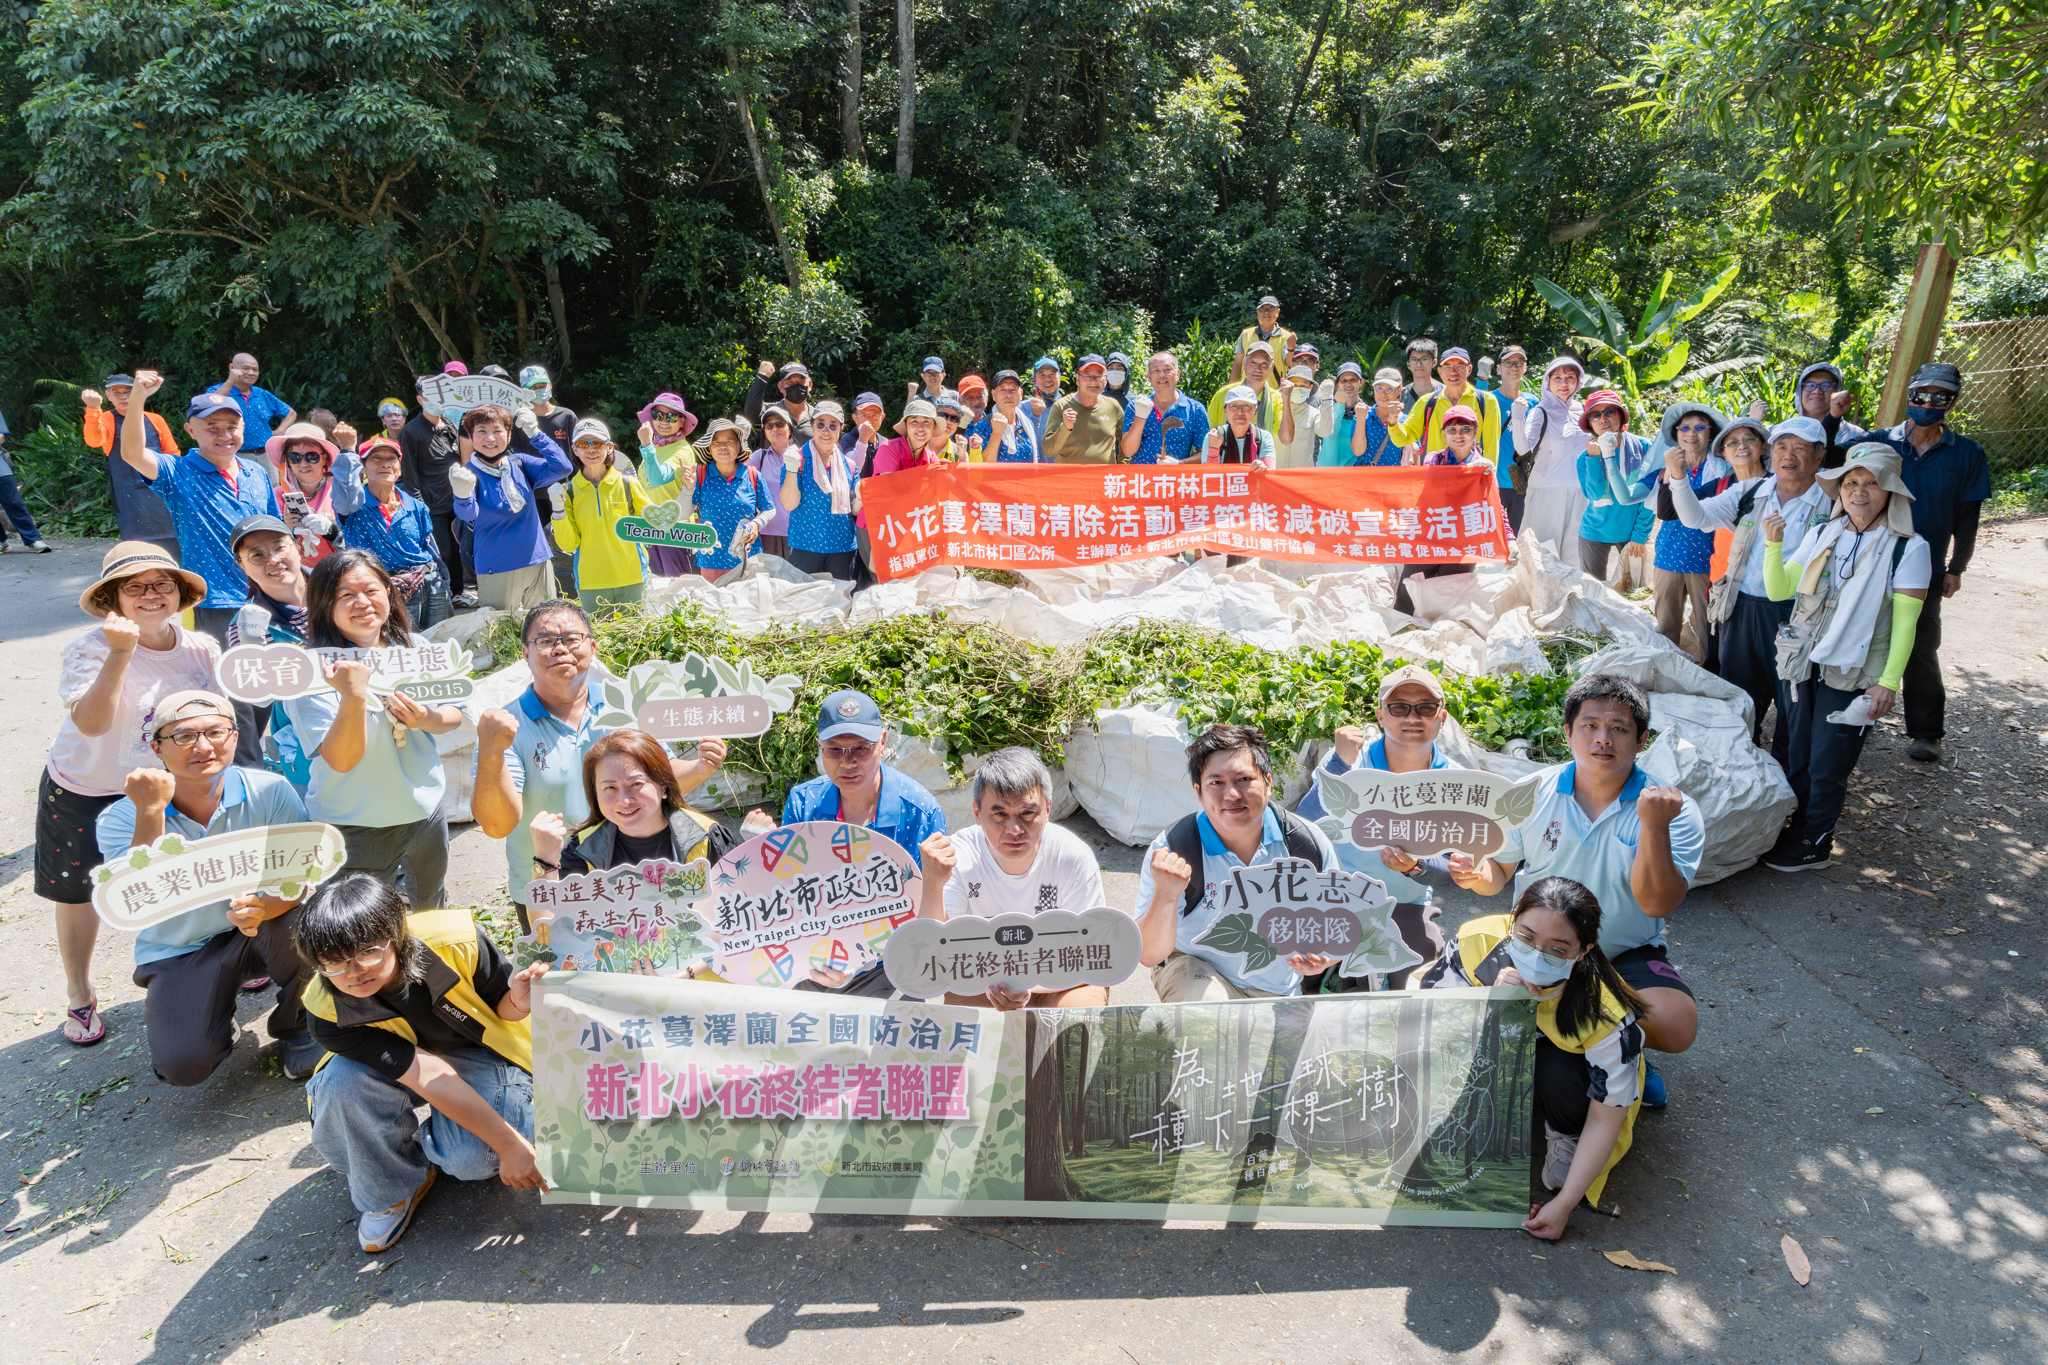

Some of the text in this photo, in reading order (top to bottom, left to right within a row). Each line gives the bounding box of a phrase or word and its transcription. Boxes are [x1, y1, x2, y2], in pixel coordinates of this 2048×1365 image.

[1103, 472, 1250, 499] 新北市林口區
[624, 523, 709, 544] Team Work
[877, 499, 1497, 548] 小花蔓澤蘭清除活動暨節能減碳宣導活動
[231, 656, 301, 690] 保育
[404, 683, 464, 700] SDG15
[663, 703, 746, 728] 生態永續
[1363, 781, 1492, 809] 小花蔓澤蘭
[1362, 817, 1490, 846] 全國防治月
[531, 876, 641, 906] 樹造美好
[715, 855, 899, 931] 新北市政府
[1223, 861, 1382, 910] 小花志工
[575, 901, 676, 933] 森生不息
[724, 899, 909, 951] New Taipei City Government
[1267, 916, 1352, 945] 移除隊
[1002, 928, 1026, 942] 新北
[920, 944, 1113, 982] 小花終結者聯盟
[579, 1011, 982, 1054] 小花蔓澤蘭全國防治月
[1160, 1036, 1348, 1107] 為地球
[586, 1062, 970, 1120] 新北小花終結者聯盟
[1128, 1064, 1405, 1167] 種下一棵樹
[639, 1159, 698, 1176] 主辦單位
